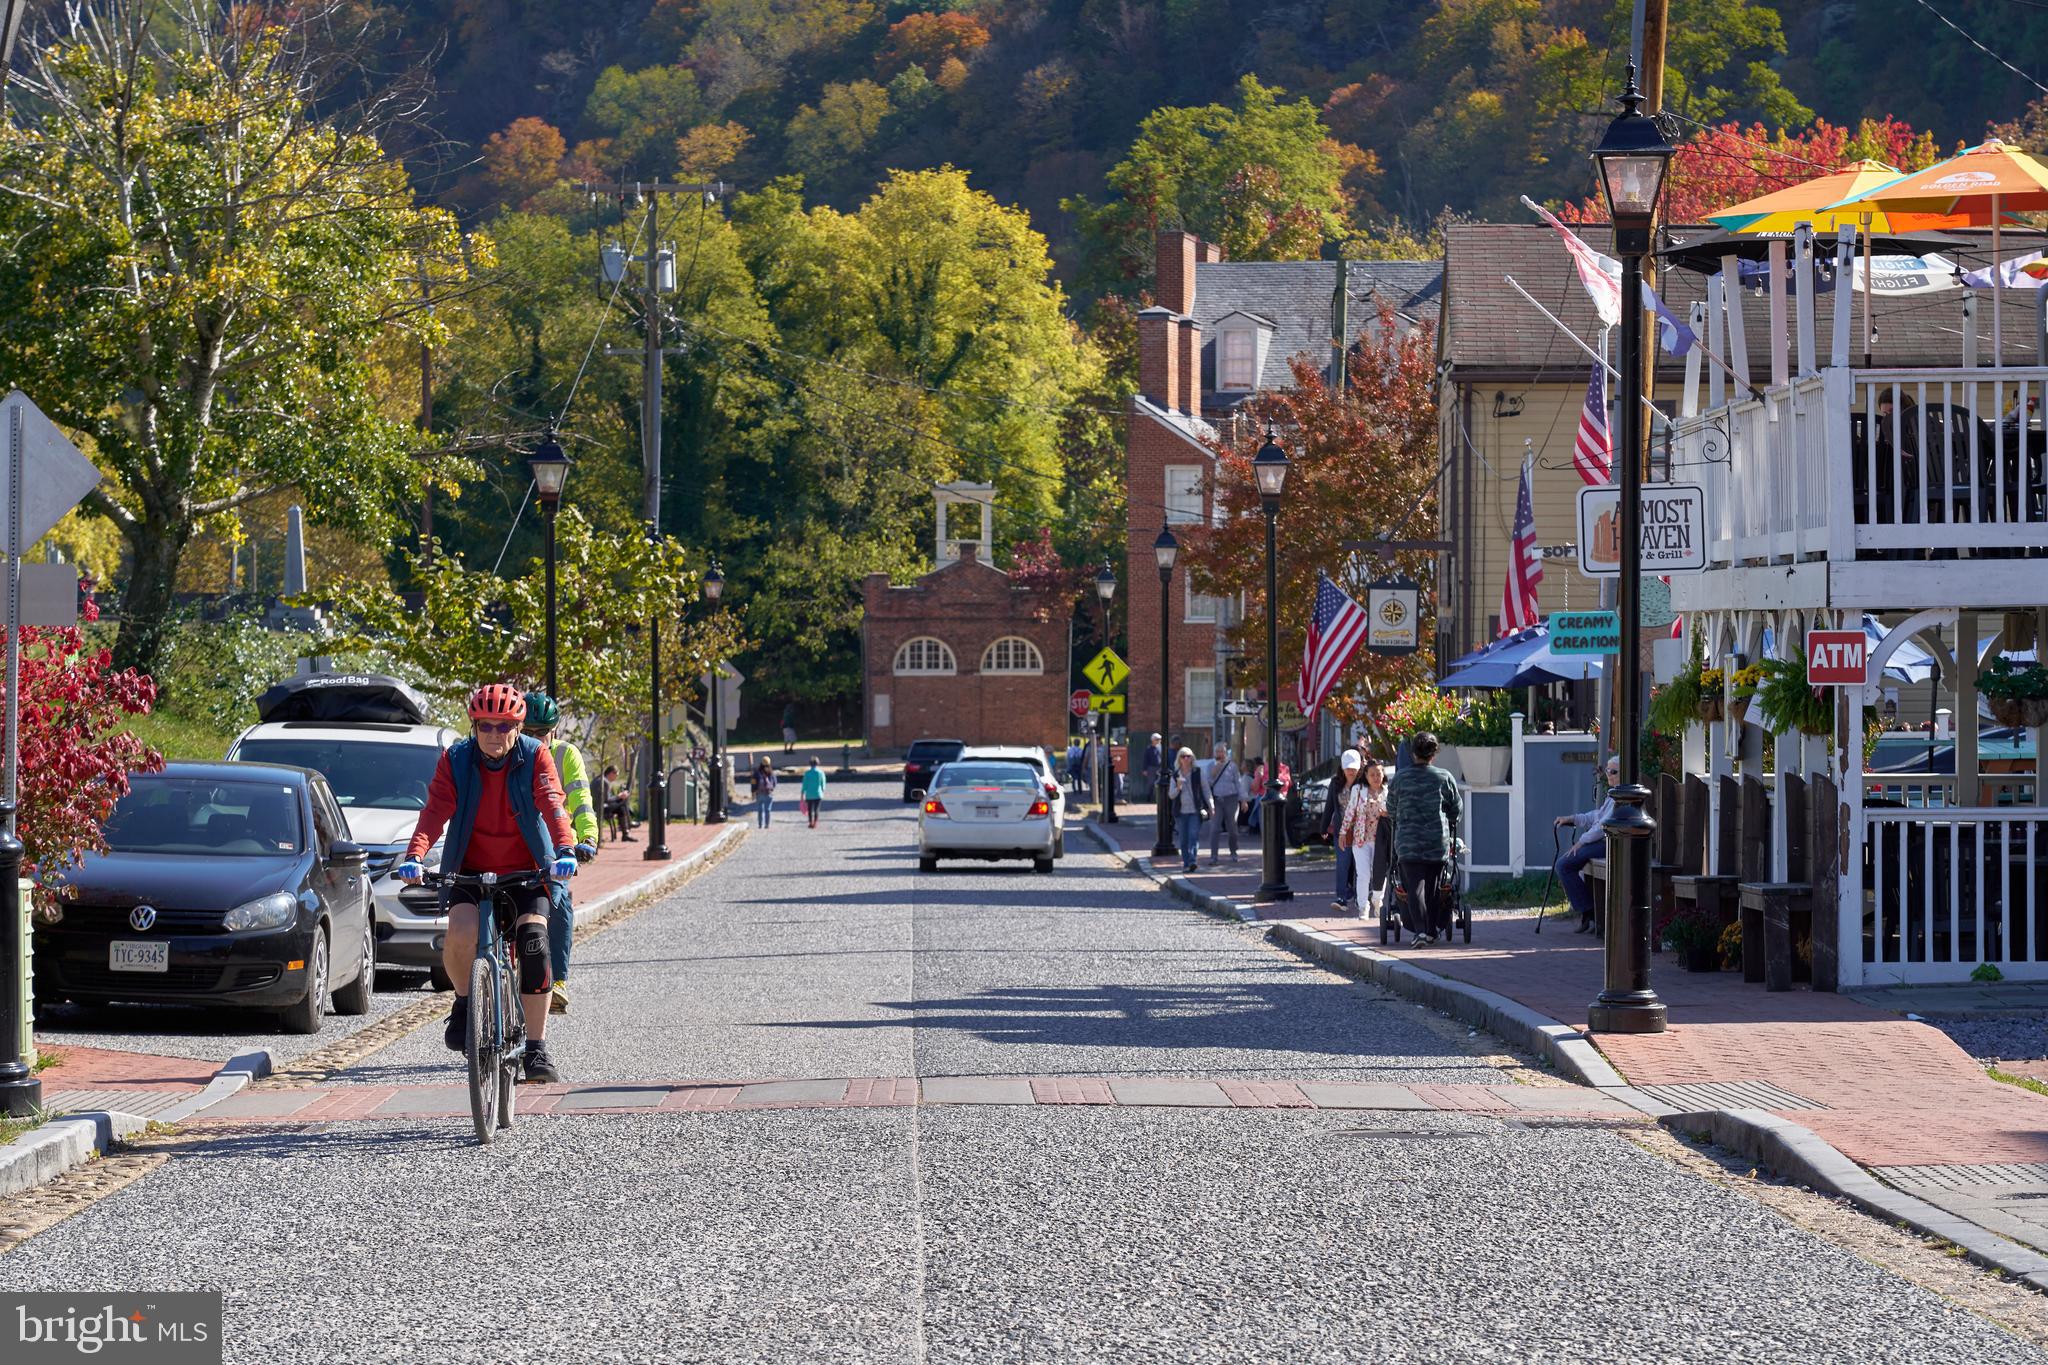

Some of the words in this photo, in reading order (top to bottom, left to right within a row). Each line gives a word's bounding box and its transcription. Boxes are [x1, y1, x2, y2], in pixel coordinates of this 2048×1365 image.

[1872, 260, 1915, 269] LIGHT
[1611, 498, 1693, 525] AMOST
[1612, 524, 1691, 551] HAVEN
[1645, 551, 1655, 560] &
[1657, 550, 1683, 559] Grill
[1557, 615, 1613, 630] CREAMY
[1553, 635, 1619, 649] CREATION
[1811, 643, 1862, 668] ATM
[320, 676, 347, 685] Roof
[347, 675, 370, 685] Bag
[1071, 697, 1089, 709] STO
